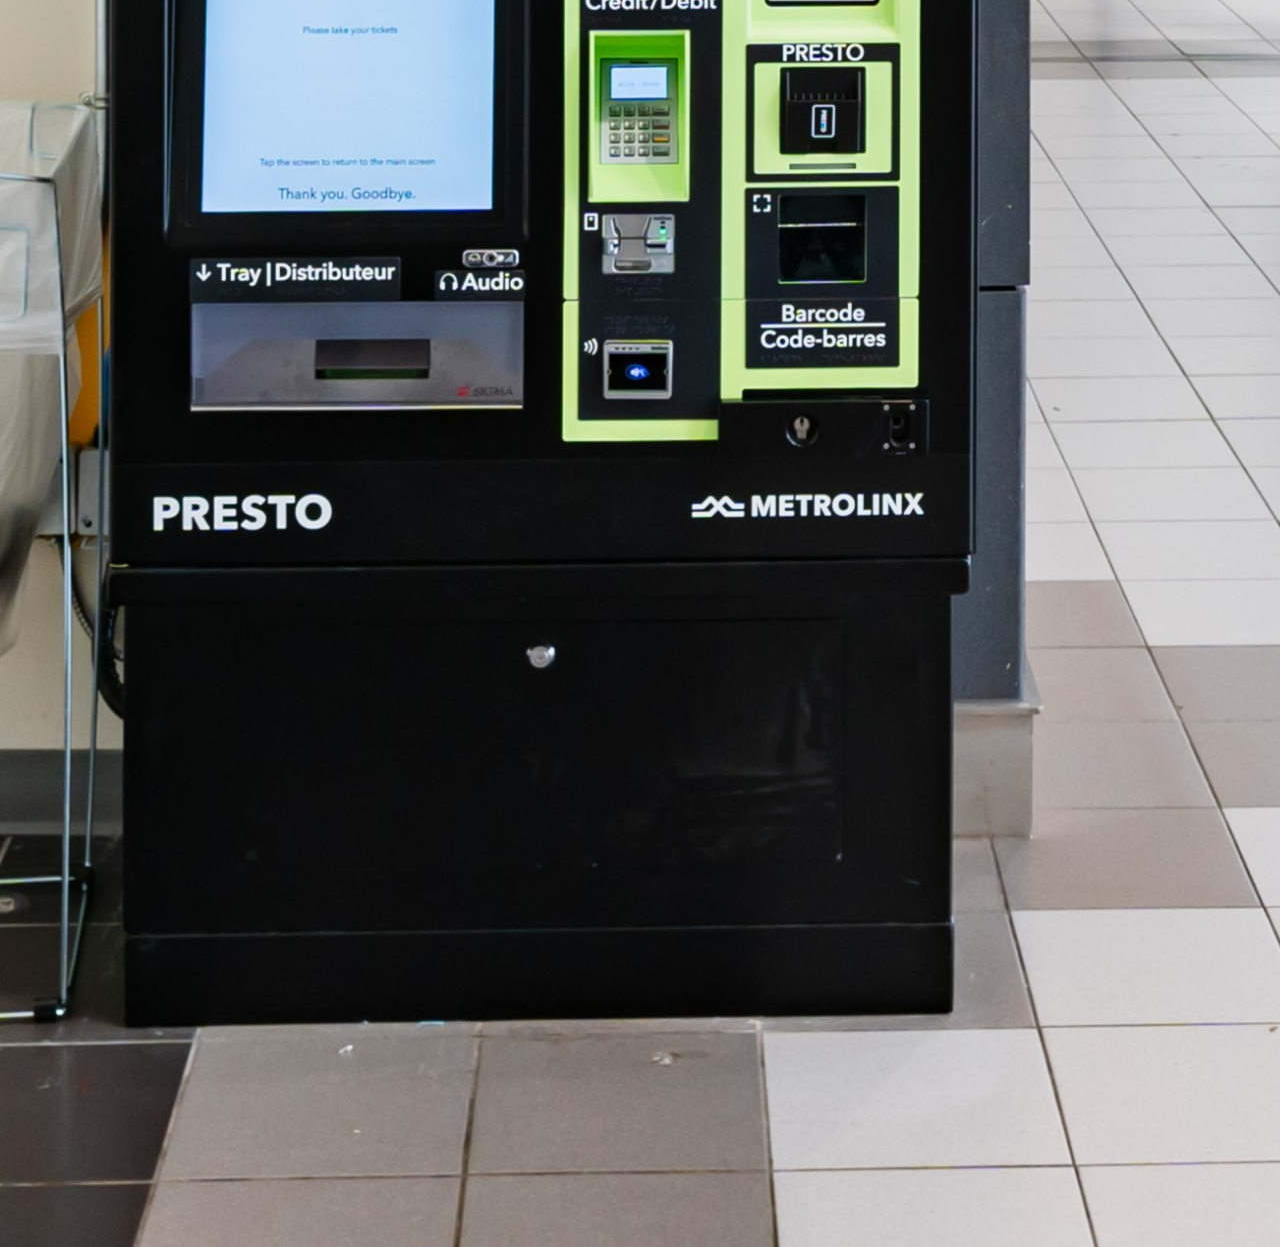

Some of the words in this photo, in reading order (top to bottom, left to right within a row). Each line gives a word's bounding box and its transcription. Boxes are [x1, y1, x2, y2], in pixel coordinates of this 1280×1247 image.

[303, 25, 329, 34] Please
[331, 25, 349, 34] take
[350, 27, 370, 36] your
[371, 25, 398, 34] tickets
[782, 44, 865, 62] PRESTO
[276, 158, 290, 166] the
[359, 158, 368, 166] to
[370, 158, 384, 166] the
[408, 158, 436, 166] screen
[278, 187, 317, 200] Thank
[320, 189, 348, 202] you.
[351, 187, 416, 202] Goodbye.
[217, 263, 262, 286] Tray
[275, 263, 396, 282] Distributeur
[461, 271, 524, 291] Audio
[781, 302, 866, 322] Barcode
[760, 329, 887, 349] Code-barres
[153, 494, 333, 531] PRESTO
[750, 493, 925, 518] METROLINX
